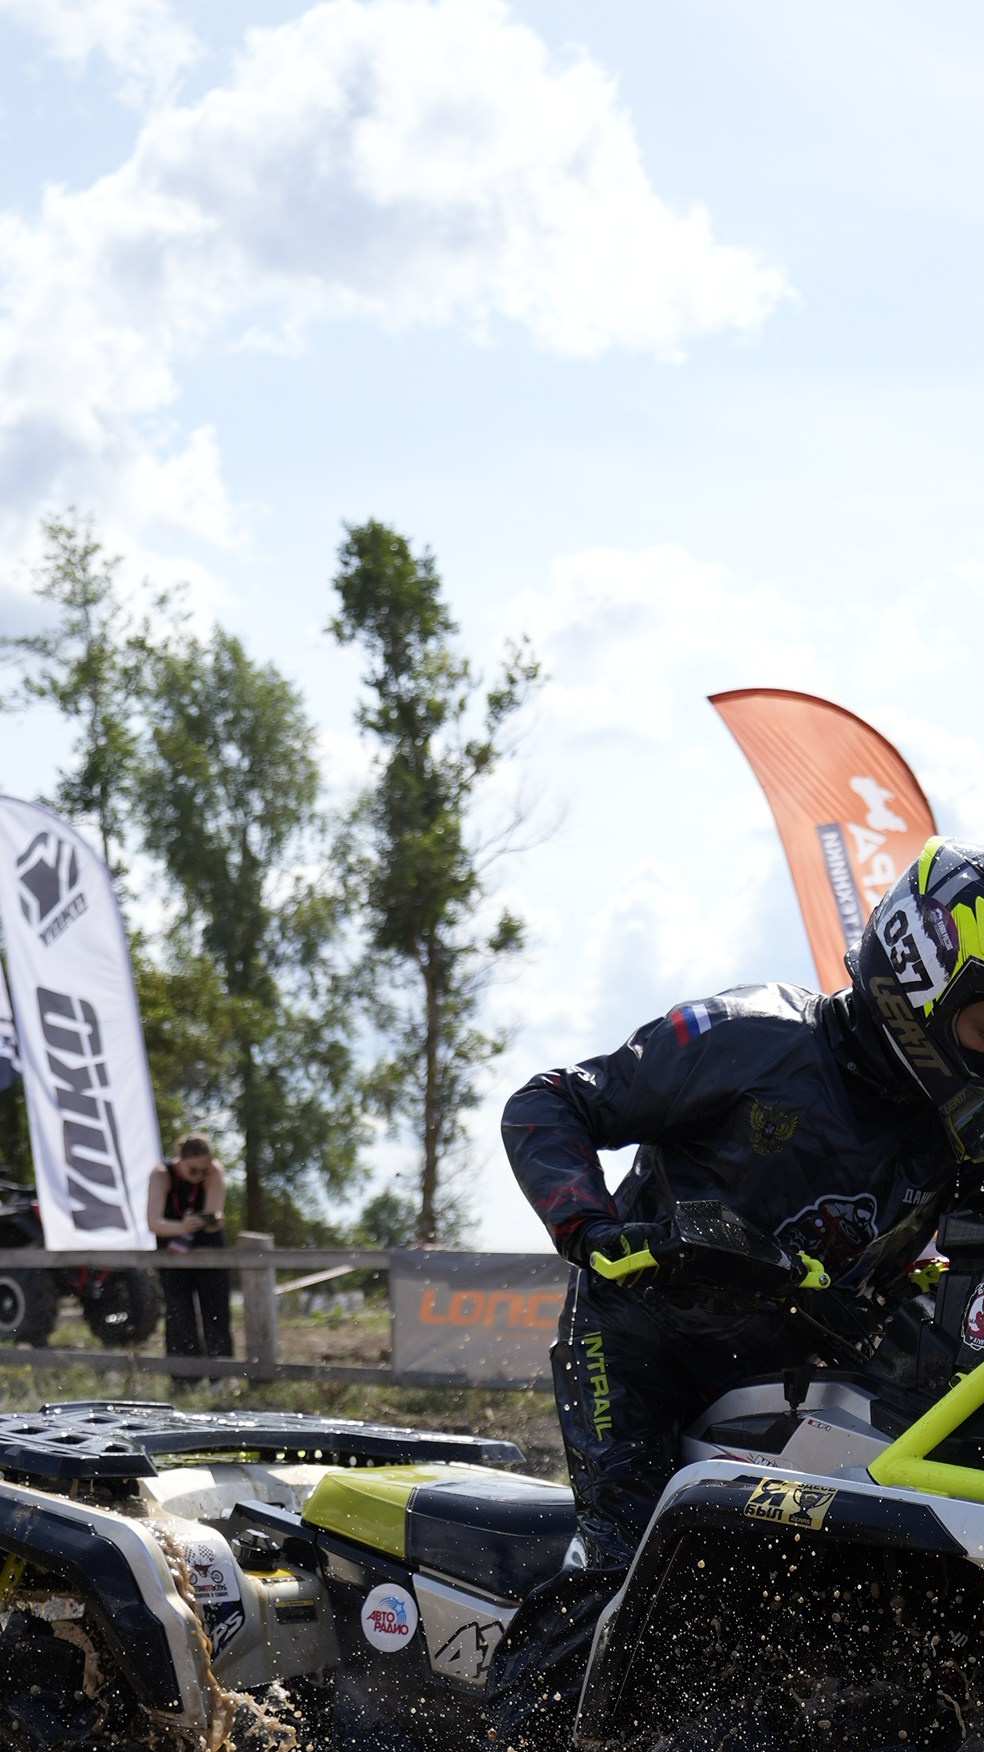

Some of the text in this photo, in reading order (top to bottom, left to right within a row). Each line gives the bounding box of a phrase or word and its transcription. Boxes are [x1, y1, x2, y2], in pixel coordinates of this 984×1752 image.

[40, 893, 90, 946] YOKO
[884, 909, 935, 1001] 037
[868, 975, 953, 1077] LEATT
[36, 986, 131, 1233] YOKO
[583, 1331, 612, 1441] NTRAIL
[744, 1503, 784, 1521] БЫЛ
[211, 1610, 244, 1653] PS
[367, 1610, 396, 1623] АВТО
[373, 1621, 409, 1636] РАДИО
